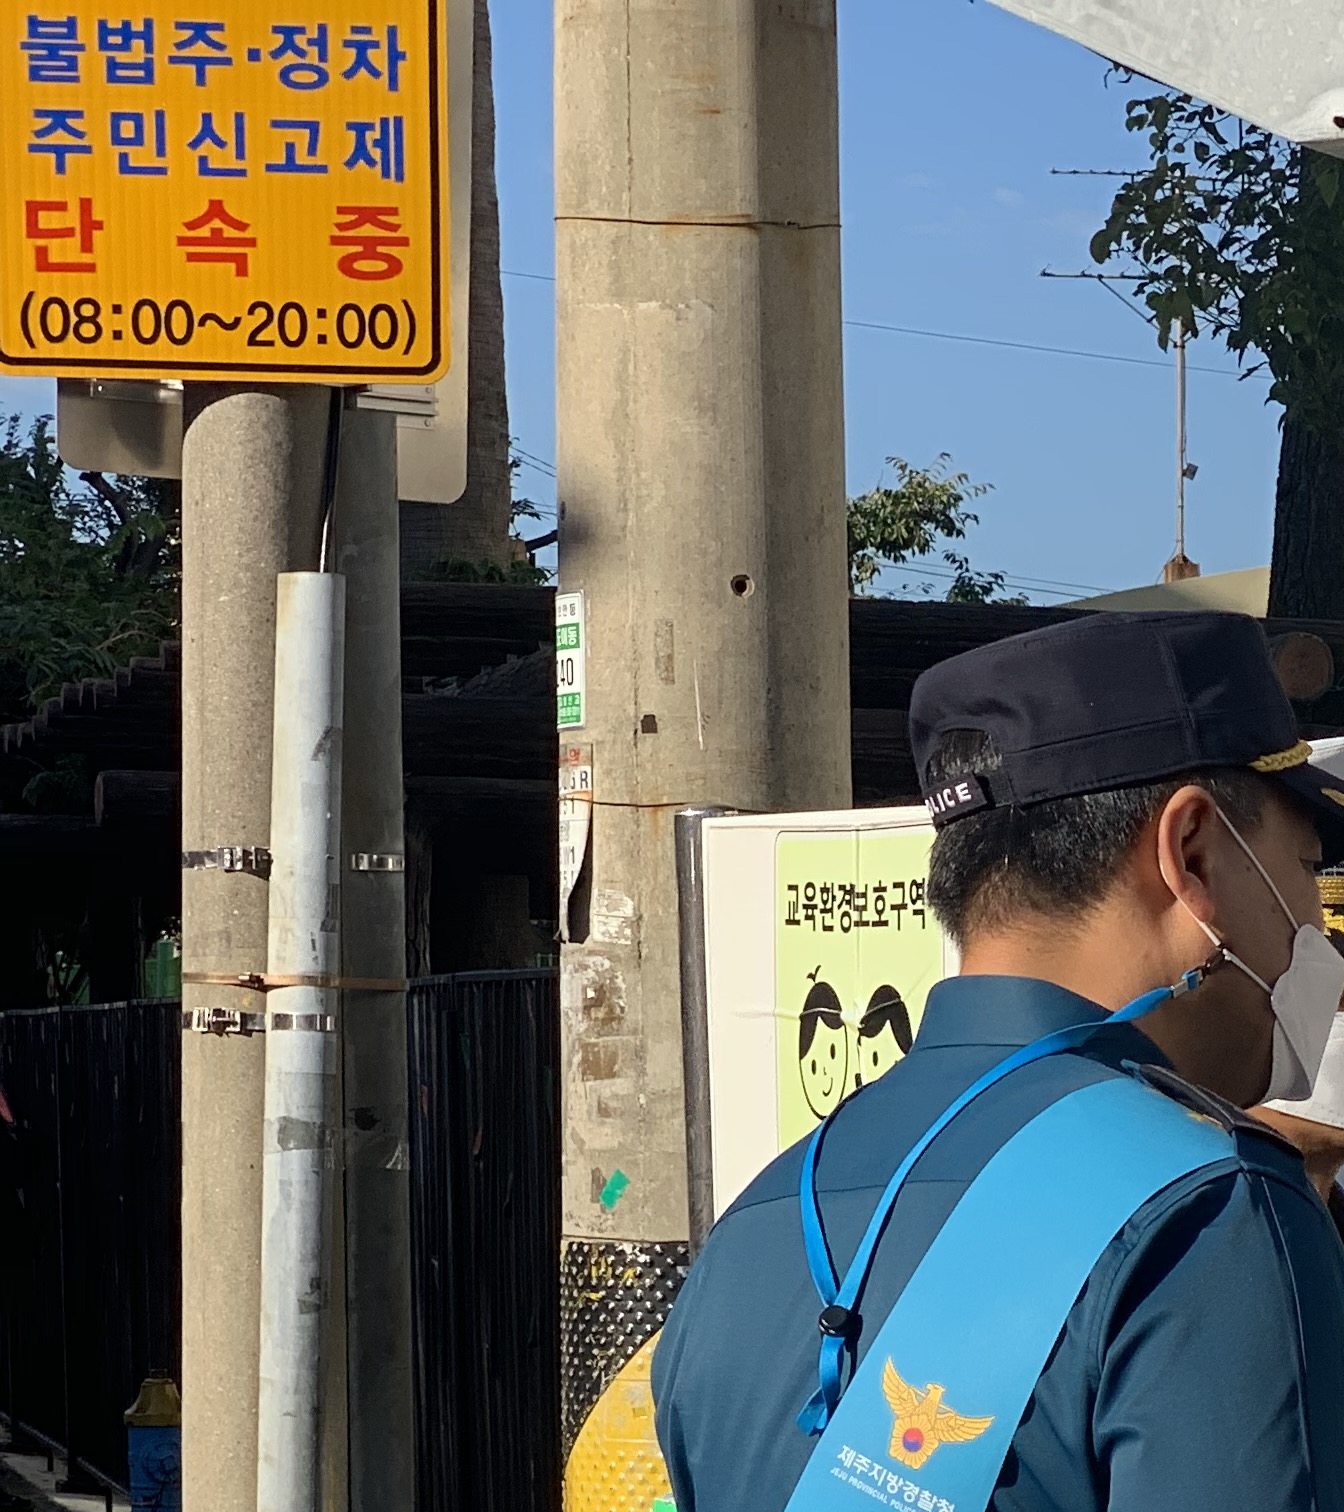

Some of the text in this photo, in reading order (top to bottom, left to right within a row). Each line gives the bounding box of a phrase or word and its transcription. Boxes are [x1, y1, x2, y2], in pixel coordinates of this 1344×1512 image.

[19, 14, 407, 92] 불법주·정차
[27, 106, 406, 183] 주민신고제
[19, 291, 418, 355] (08:00~20:00)
[925, 782, 972, 817] LICE
[785, 877, 925, 934] 교육환경보호구역
[829, 1467, 849, 1481] JEJU
[847, 1475, 888, 1504] PROVINCIAL
